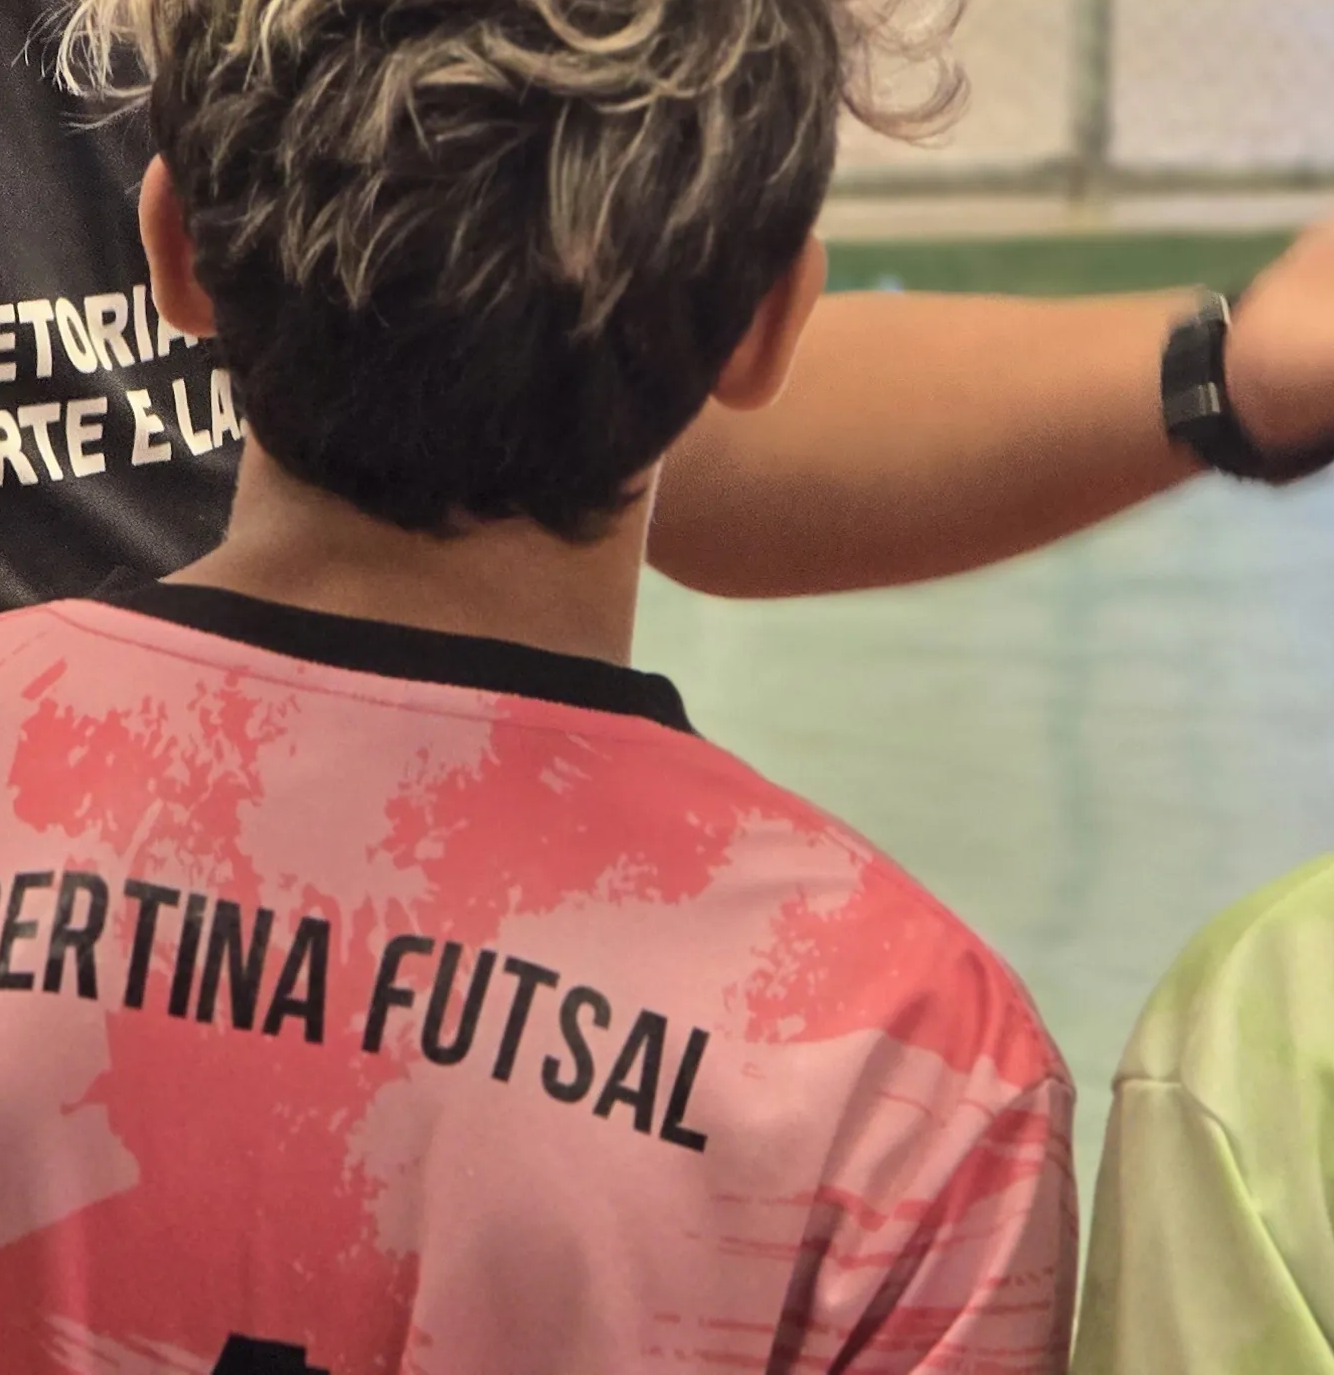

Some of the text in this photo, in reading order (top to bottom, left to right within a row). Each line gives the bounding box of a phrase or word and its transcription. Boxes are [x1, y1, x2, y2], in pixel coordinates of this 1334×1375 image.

[126, 388, 172, 467] E
[172, 368, 251, 457] LA
[361, 933, 711, 1153] FUTSAL
